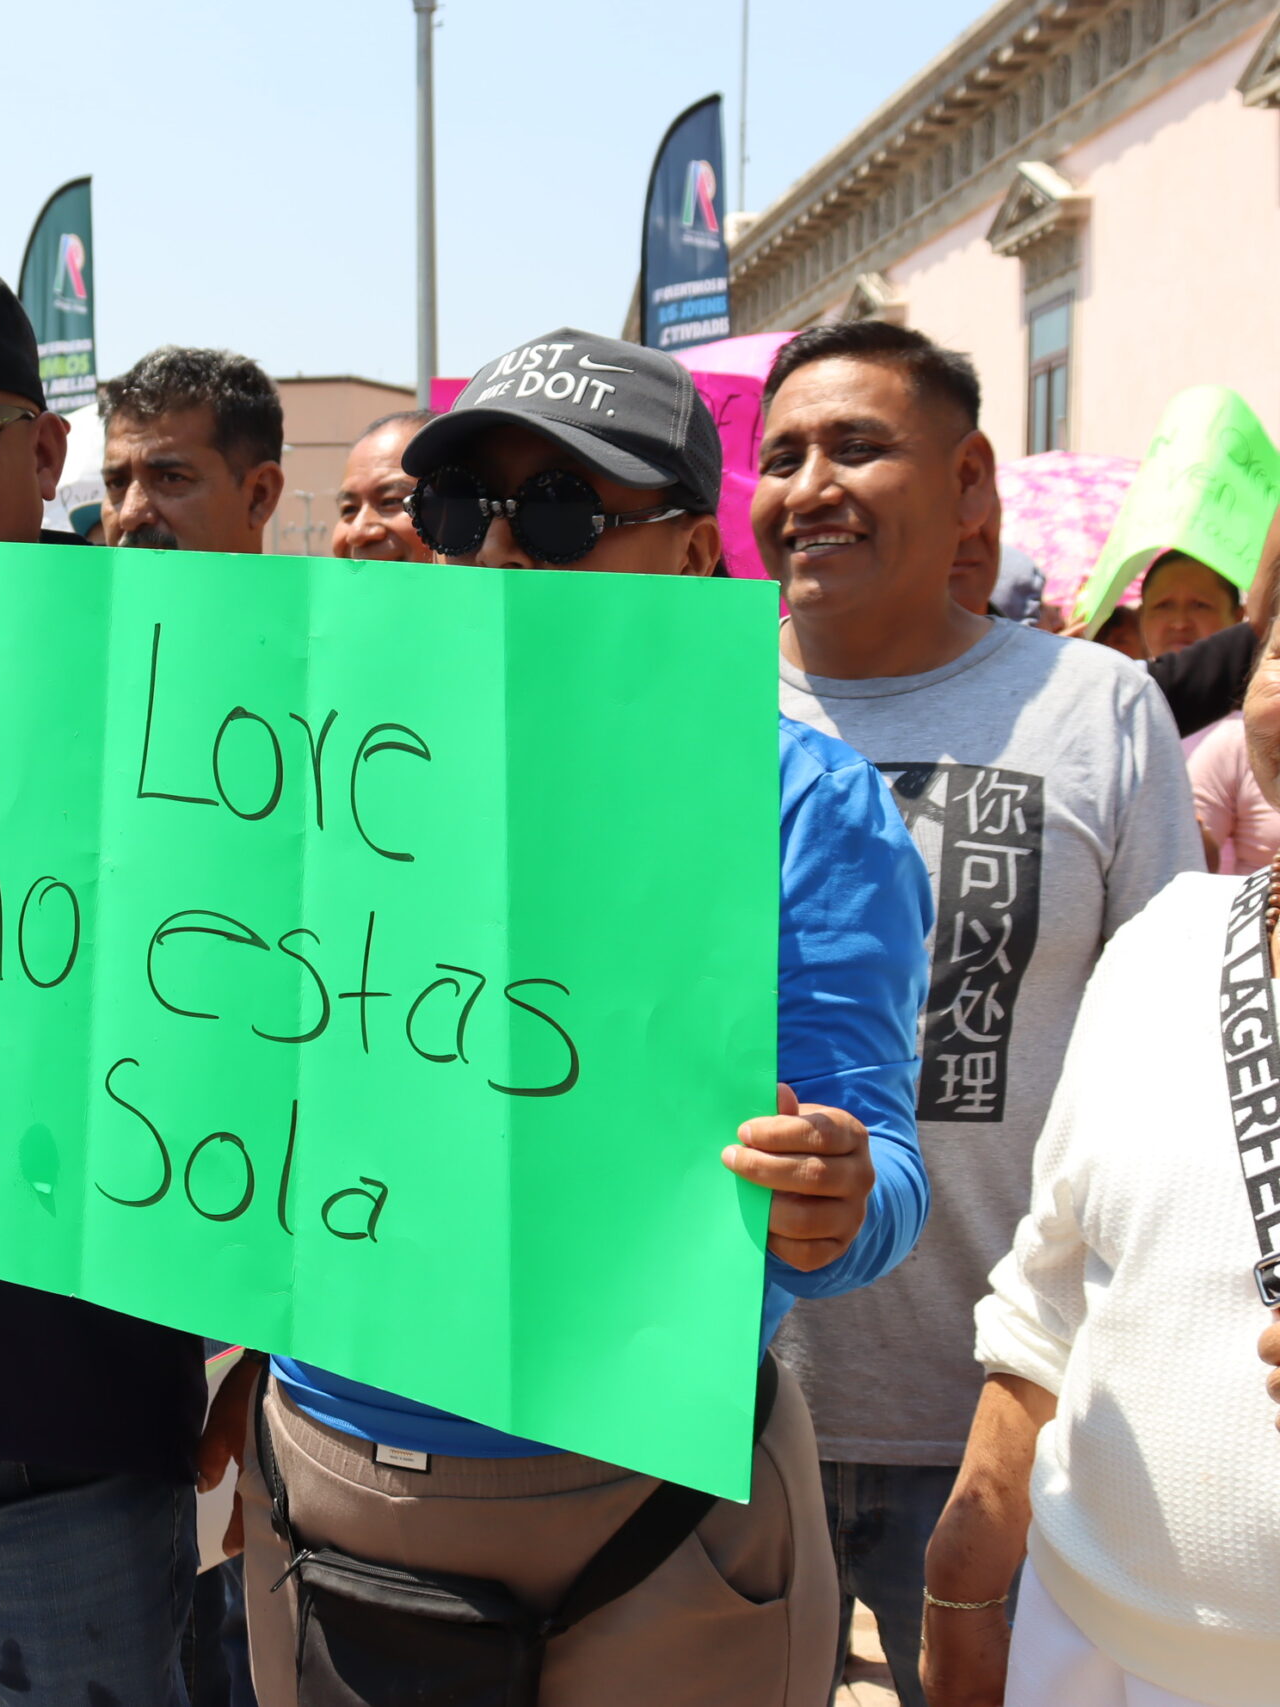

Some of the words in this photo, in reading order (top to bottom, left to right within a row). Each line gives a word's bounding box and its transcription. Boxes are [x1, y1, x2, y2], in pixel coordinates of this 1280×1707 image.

[486, 343, 575, 383] JUST
[136, 622, 432, 863] Lore
[146, 909, 581, 1098] estas
[934, 768, 1033, 1116] 你可以处理
[94, 1057, 390, 1243] Sola
